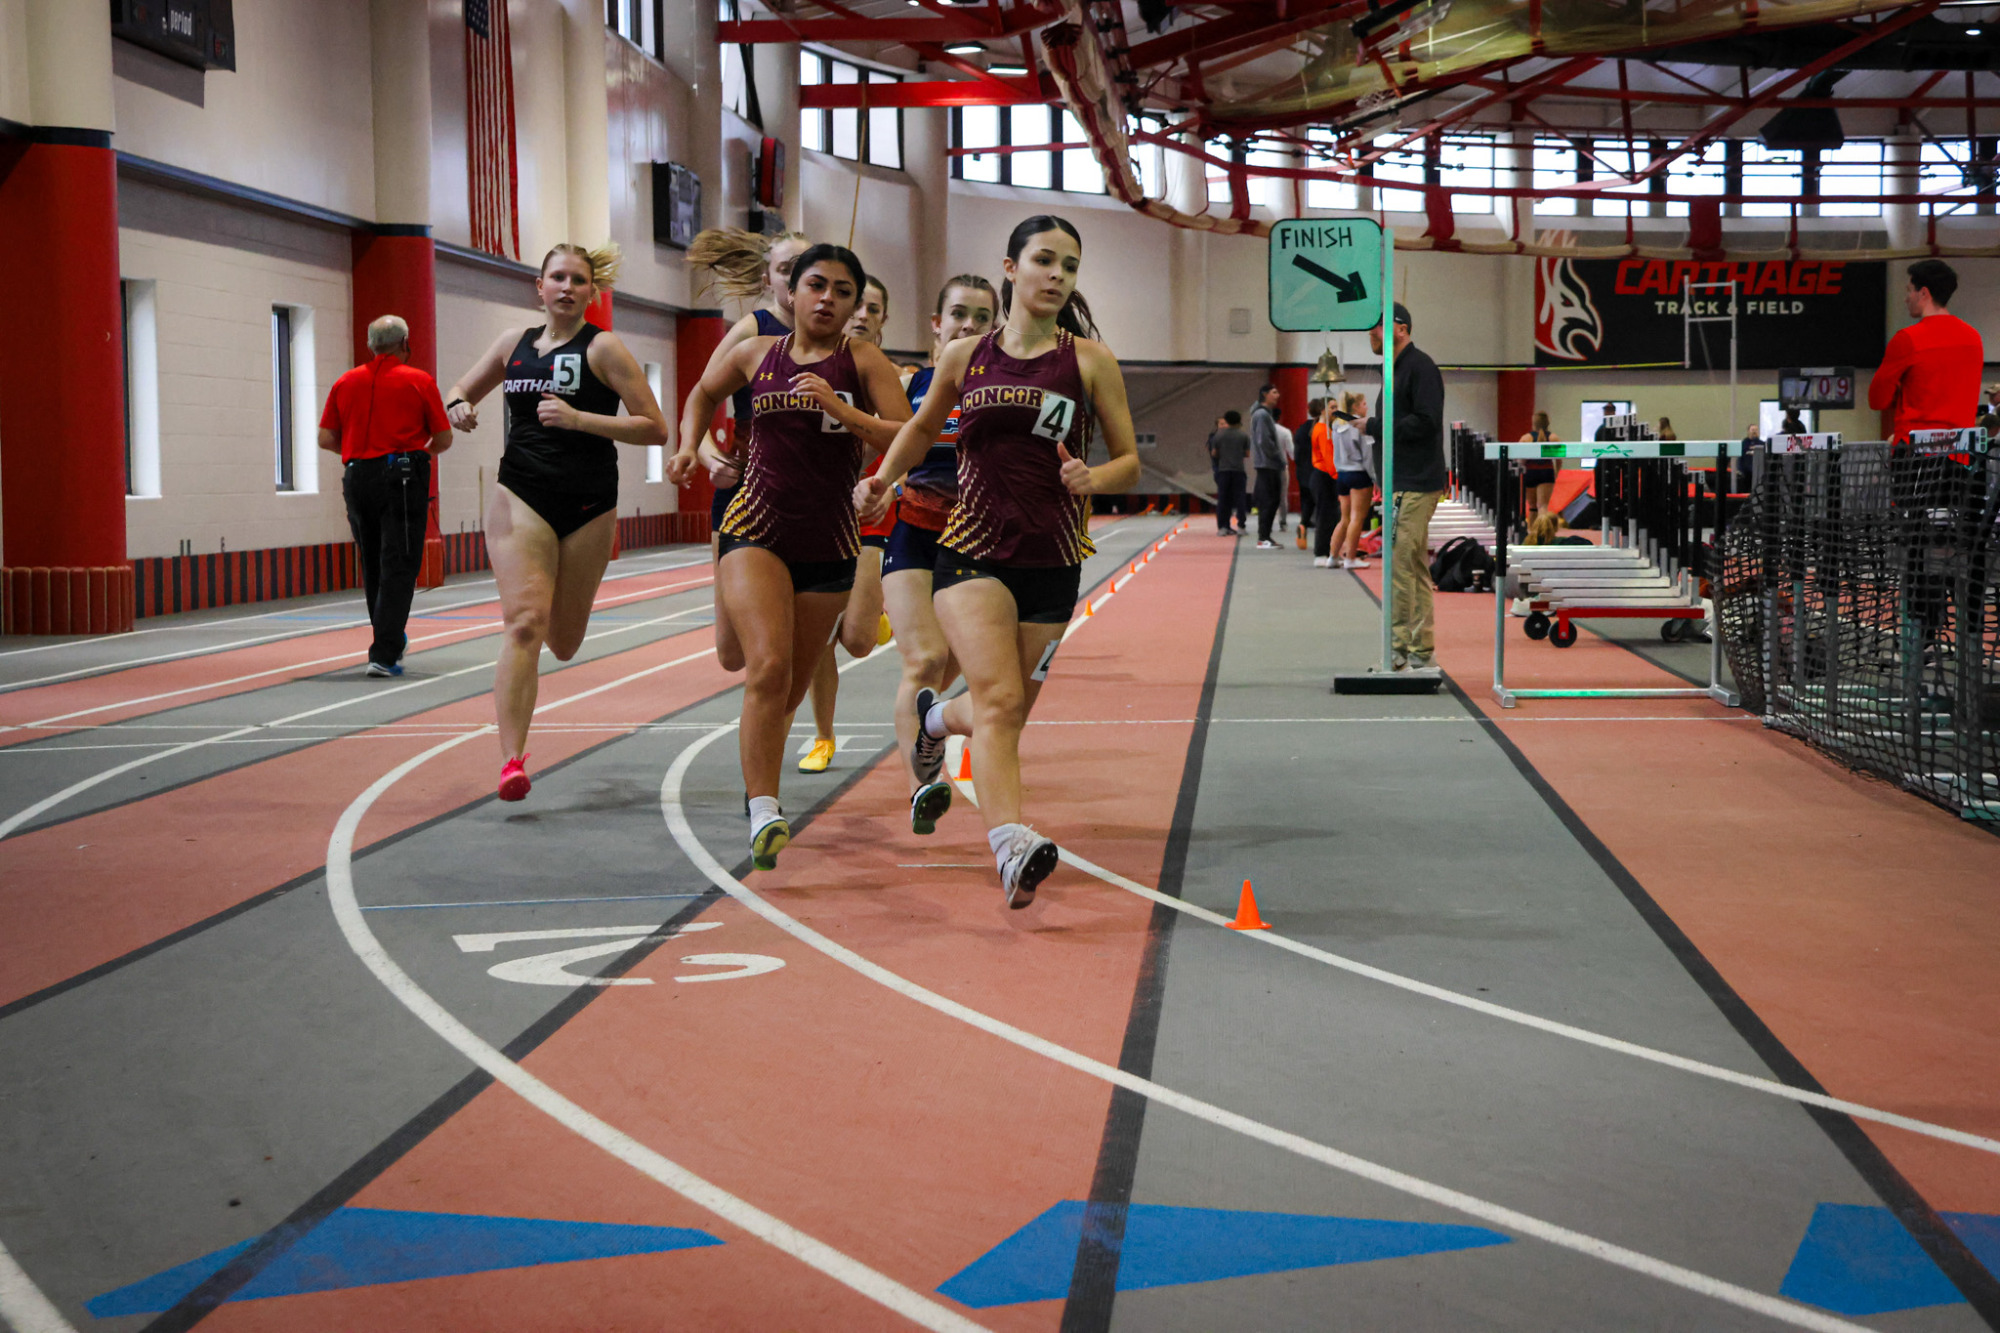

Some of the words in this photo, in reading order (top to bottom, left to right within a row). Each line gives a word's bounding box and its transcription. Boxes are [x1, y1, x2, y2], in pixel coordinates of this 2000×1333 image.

[171, 10, 192, 35] period
[1282, 227, 1352, 249] FINISH
[1614, 260, 1847, 295] CARTHAGE
[1655, 302, 1718, 314] TRACK
[1747, 302, 1804, 314] FIELD
[560, 357, 575, 386] 5
[1041, 400, 1067, 438] 4
